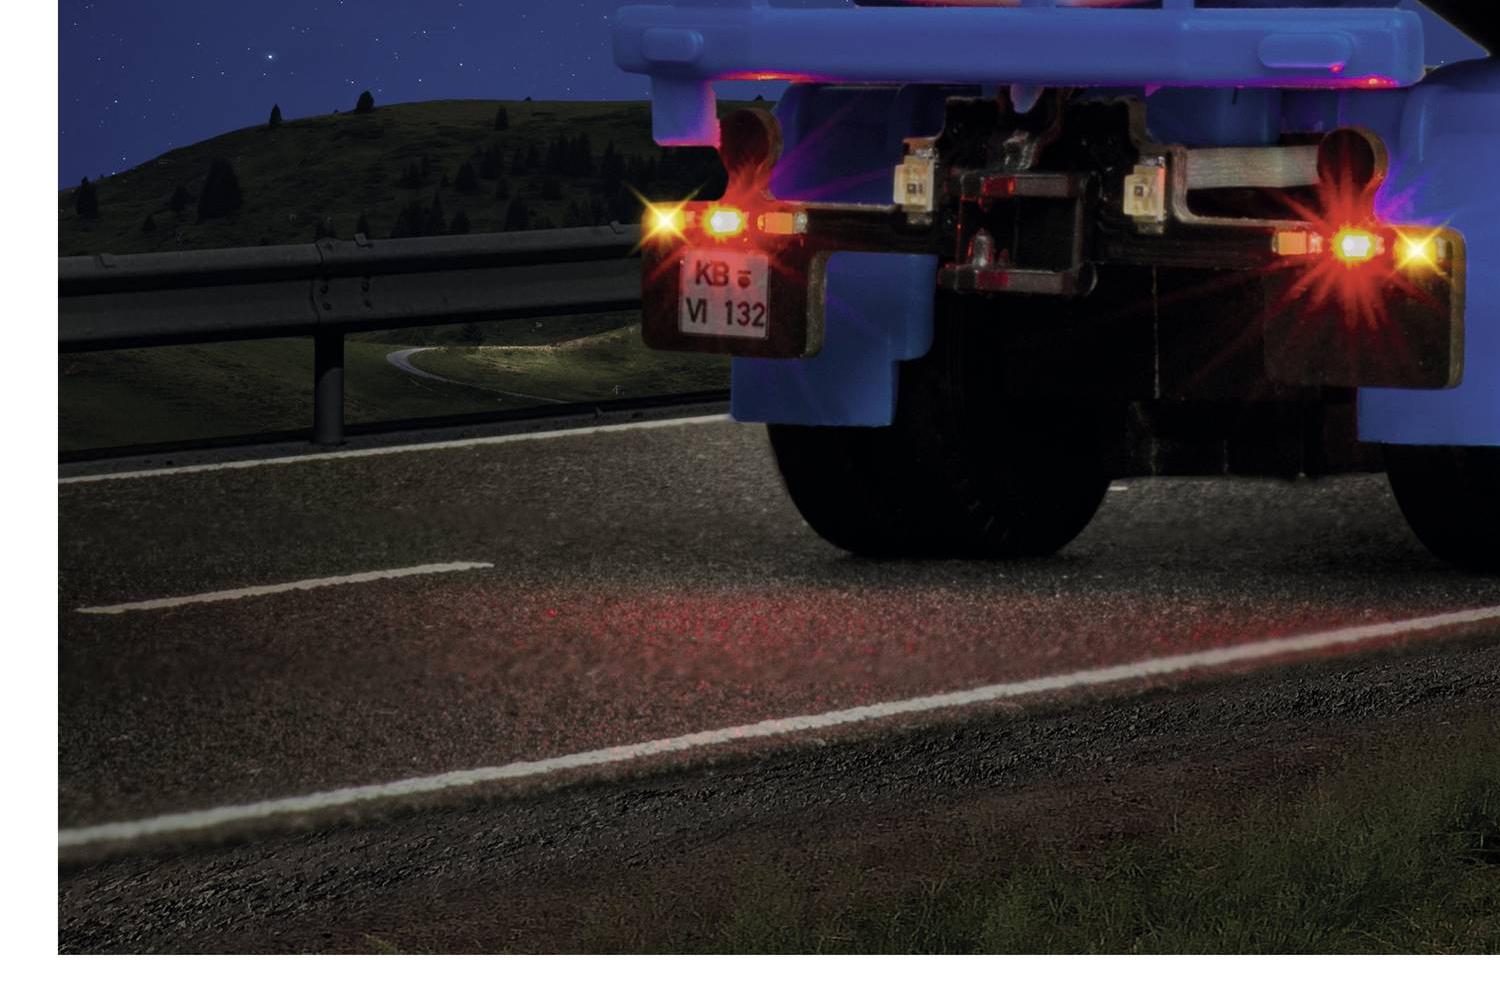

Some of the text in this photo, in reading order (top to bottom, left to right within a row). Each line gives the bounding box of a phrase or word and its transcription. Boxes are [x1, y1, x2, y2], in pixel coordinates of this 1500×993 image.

[695, 259, 729, 287] KB
[686, 297, 765, 327] VI 132
